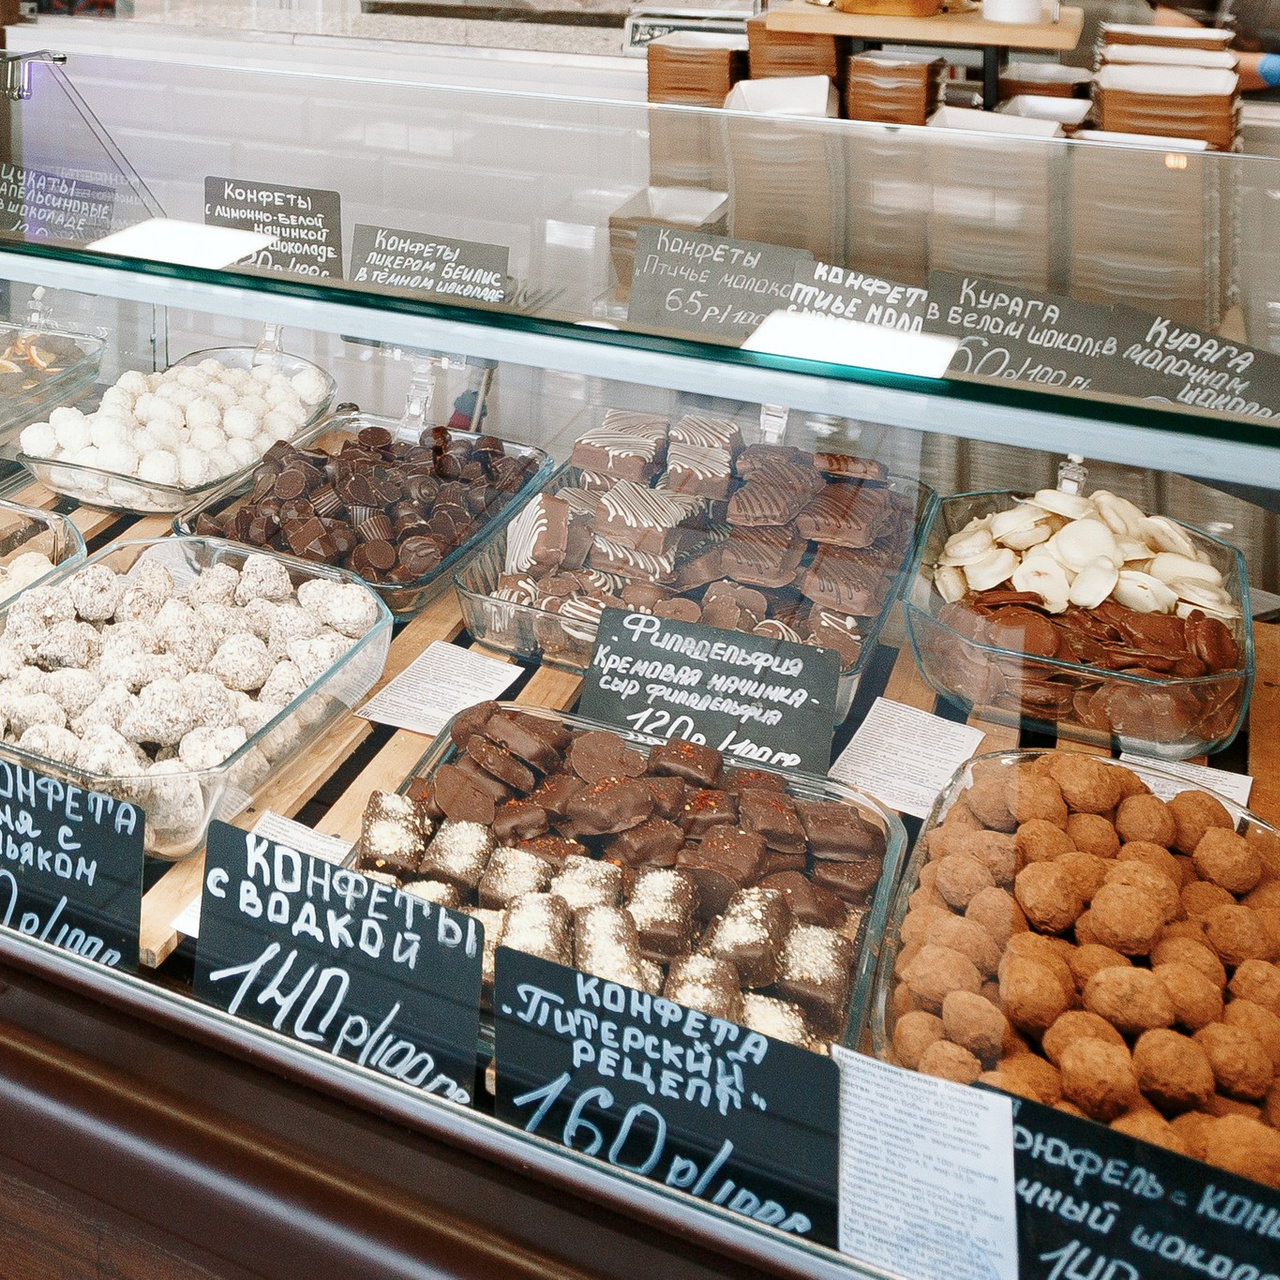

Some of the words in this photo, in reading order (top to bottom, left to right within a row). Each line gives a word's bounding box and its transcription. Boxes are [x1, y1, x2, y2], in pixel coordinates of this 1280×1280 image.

[0, 163, 77, 197] ЦУКАТЫ
[223, 181, 312, 211] КОНФЕТЫ
[7, 201, 87, 231] ШОКОЛАДЕ
[374, 228, 461, 262] КОНФЕТЫ
[656, 228, 762, 269] КОНФЕТЫ
[959, 277, 1061, 325] КУРАГА
[1145, 315, 1256, 374] КУРАГА
[592, 643, 704, 688] КРЕМОВАЯ
[598, 674, 641, 701] СЫР
[245, 832, 478, 959] КОНФЕТЫ
[238, 879, 422, 971] ВОДКОЙ
[575, 972, 770, 1066] КОНФЕТА
[1013, 1123, 1166, 1200] РЮФЕЛЬ
